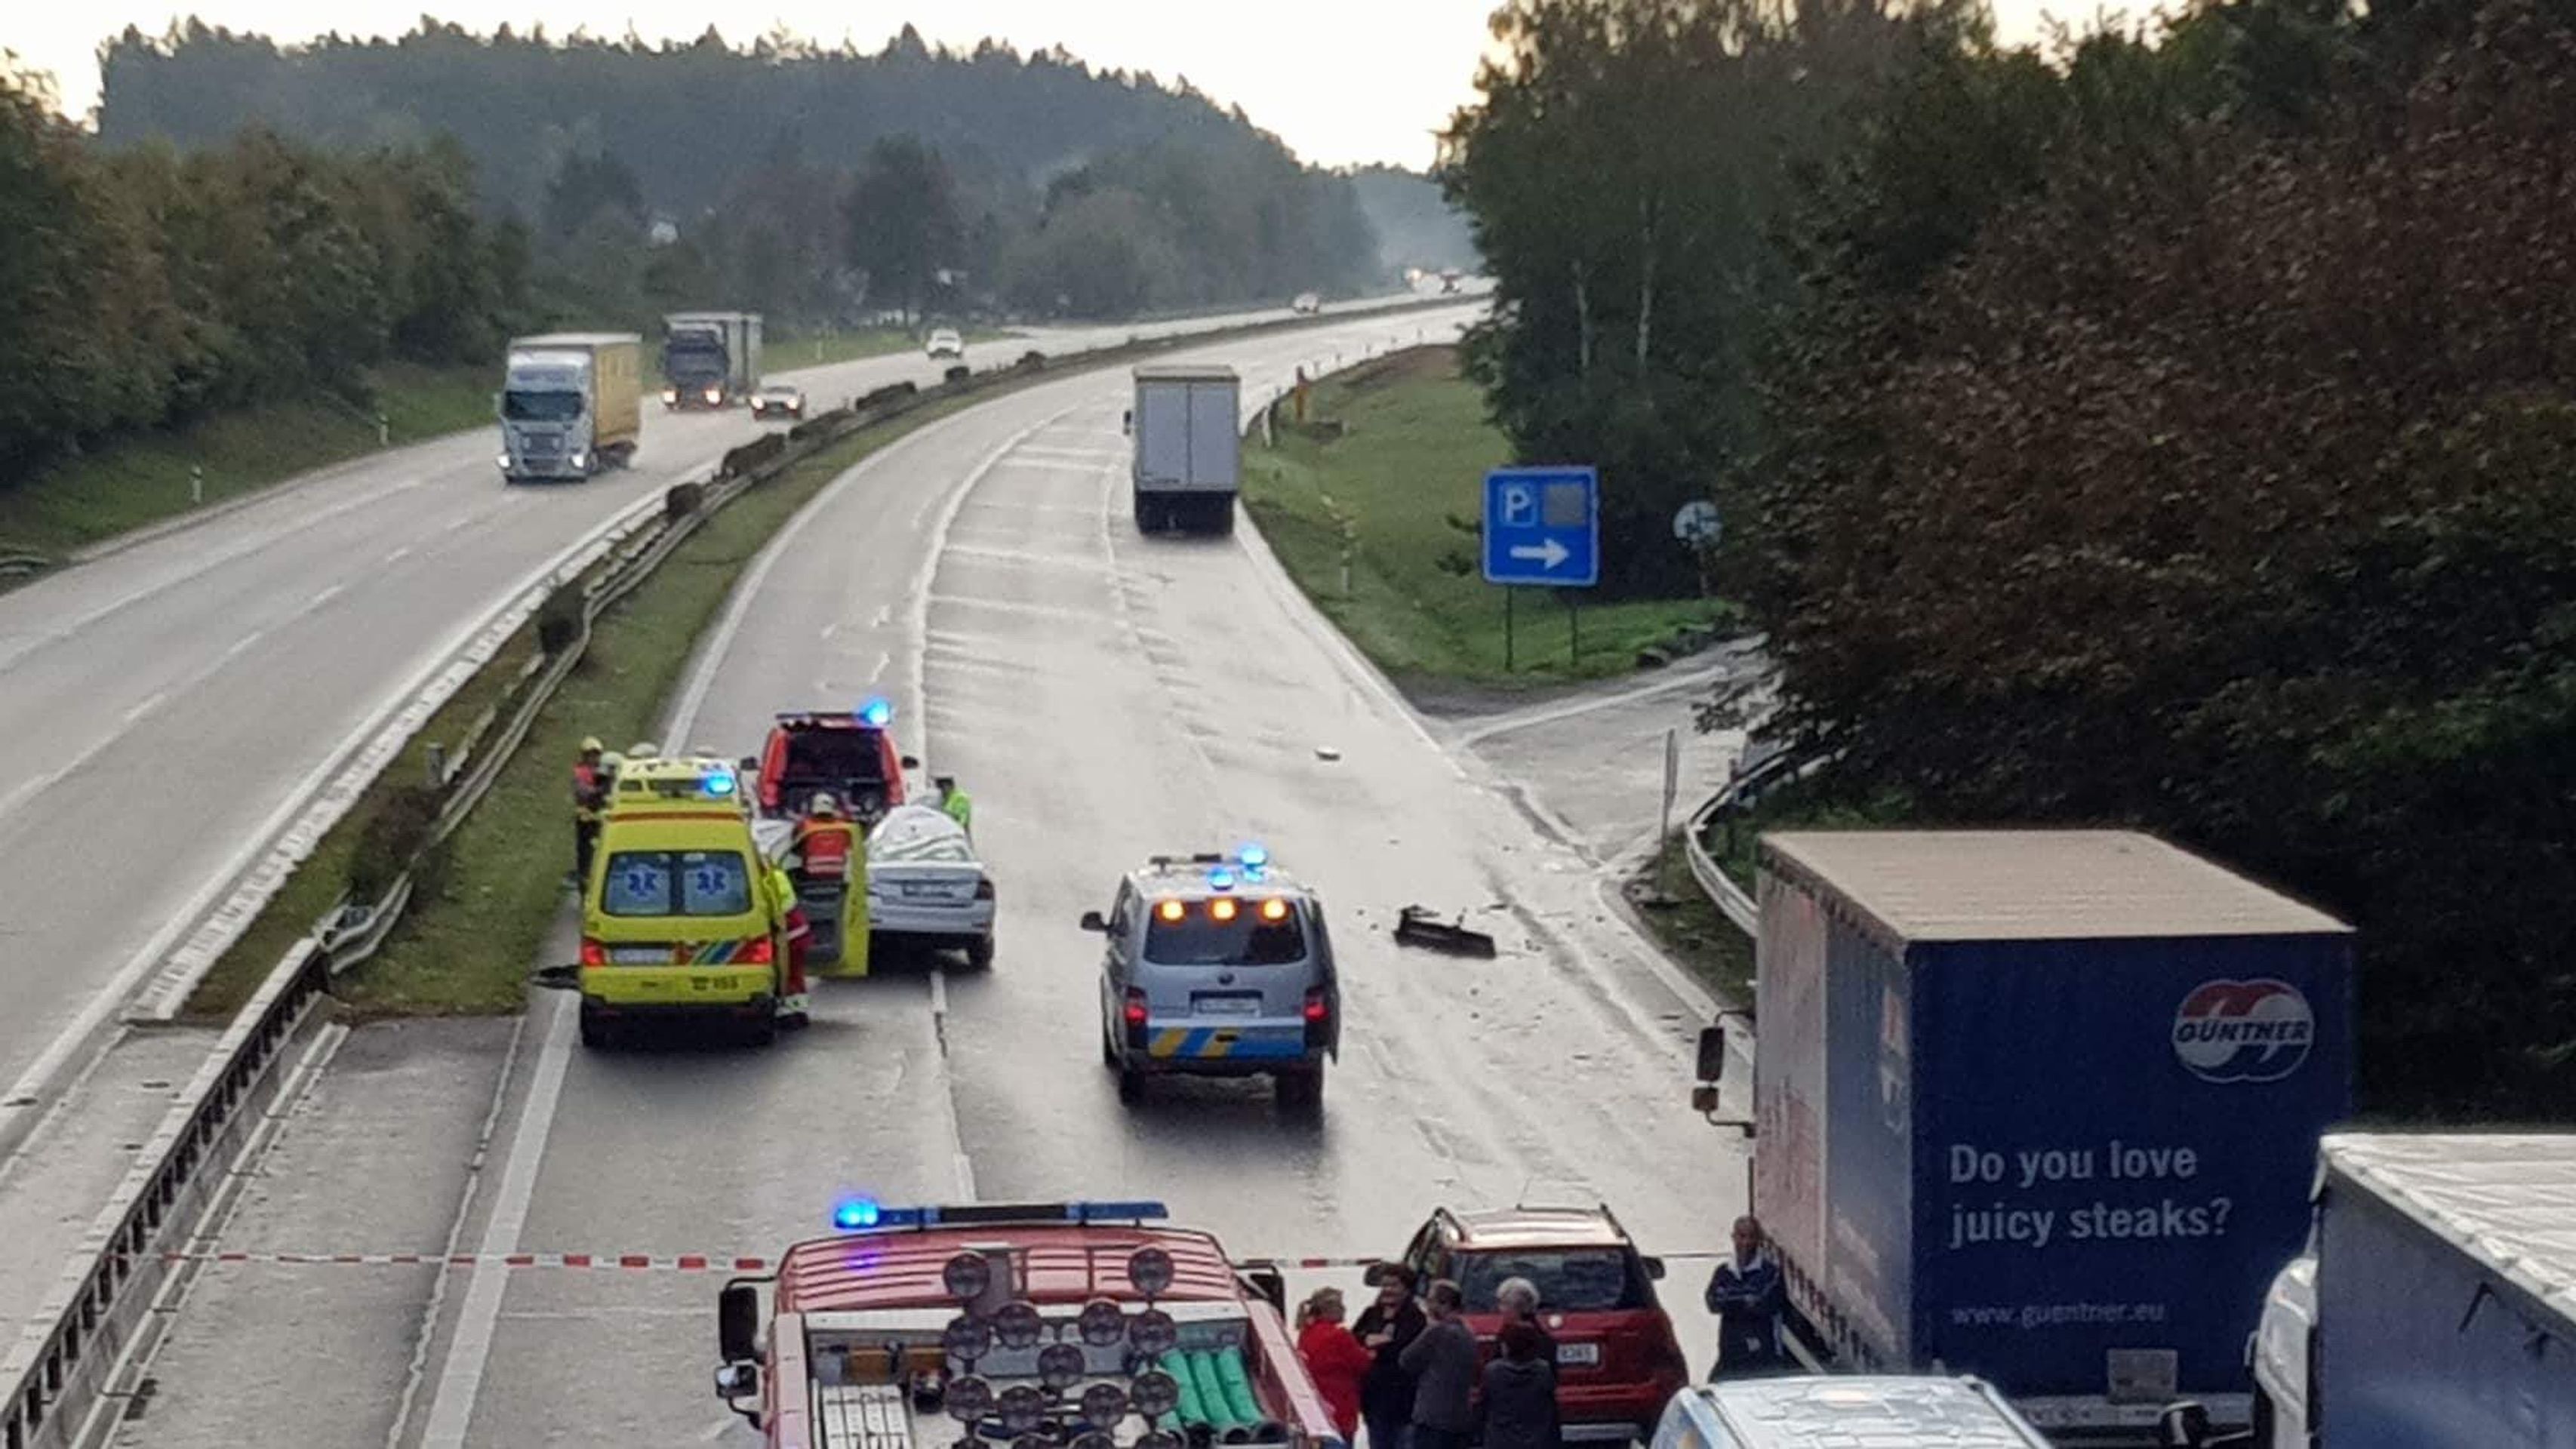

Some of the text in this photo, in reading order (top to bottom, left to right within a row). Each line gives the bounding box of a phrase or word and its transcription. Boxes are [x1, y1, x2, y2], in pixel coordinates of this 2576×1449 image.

[1505, 488, 1531, 521] P
[1950, 1140, 2197, 1189] Do you love
[1950, 1197, 2232, 1249] juicy steaks?
[1953, 1303, 2165, 1328] www.guentner.eu
